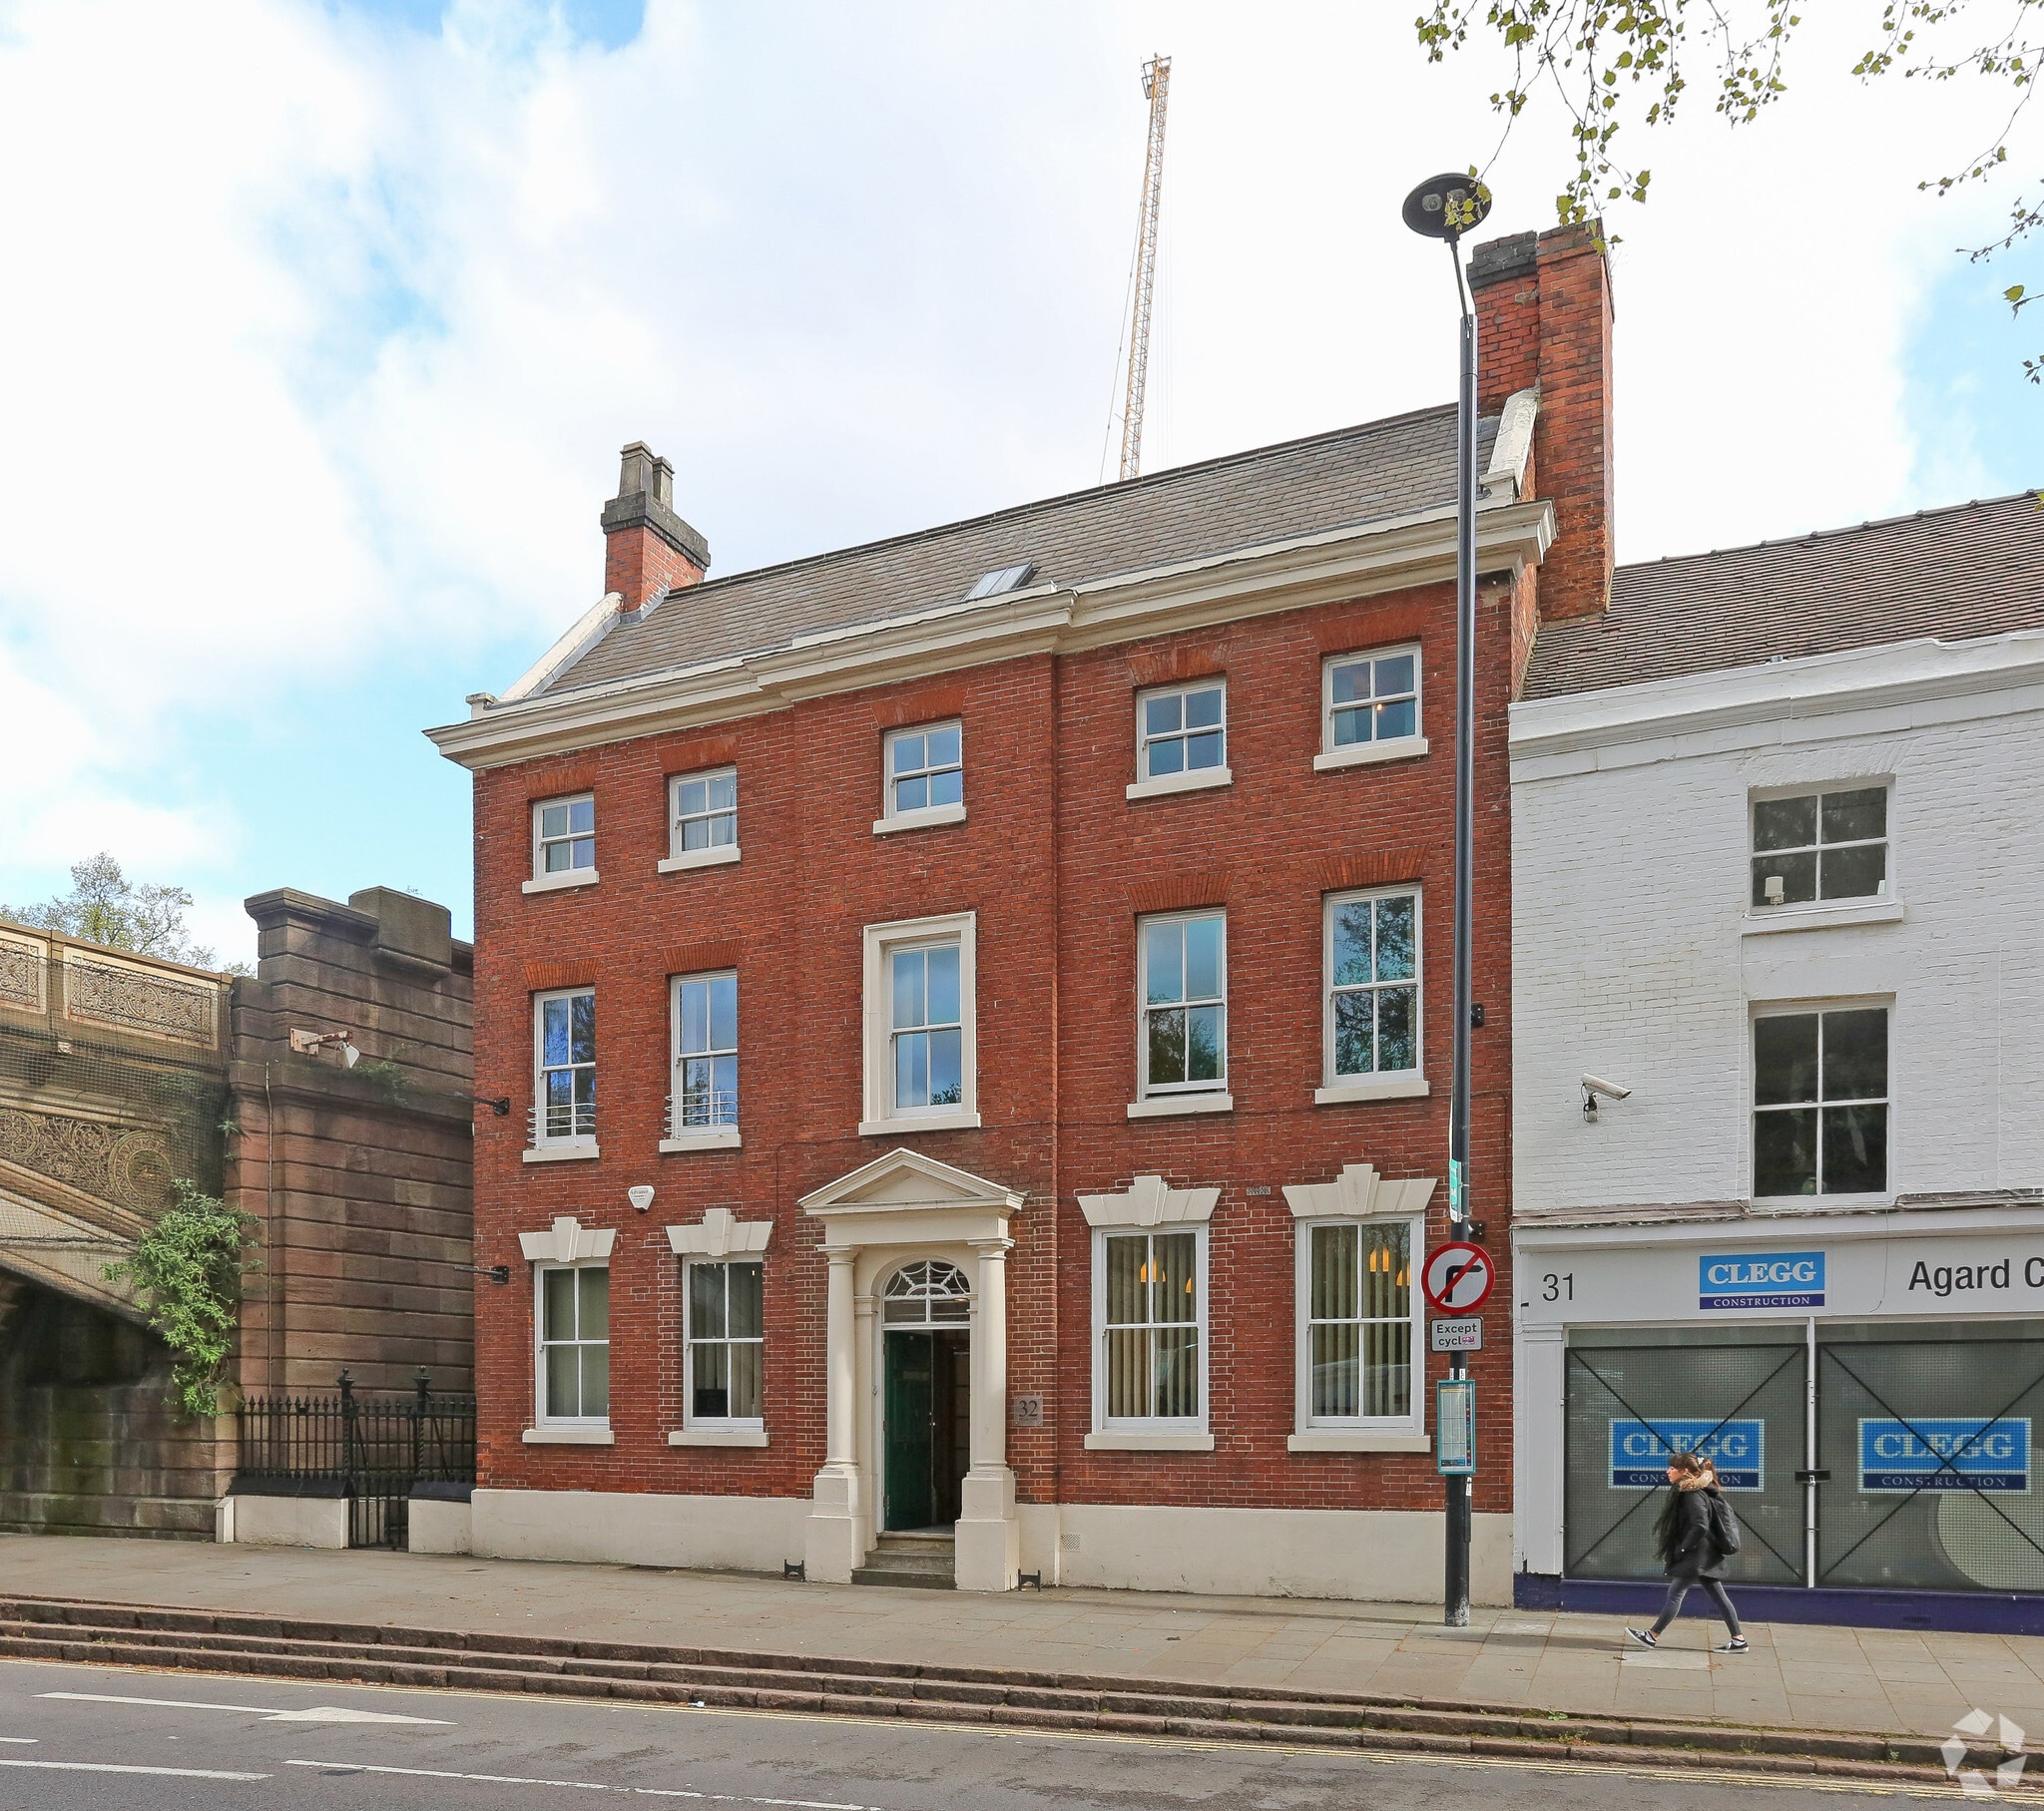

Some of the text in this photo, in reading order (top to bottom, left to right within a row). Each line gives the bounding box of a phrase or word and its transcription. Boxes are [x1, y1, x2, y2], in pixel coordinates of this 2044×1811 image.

[1708, 1261, 1816, 1285] CLEGG
[1908, 1258, 2010, 1297] Agard
[1542, 1272, 1574, 1302] 31
[1714, 1296, 1810, 1307] CONSTRUCTION
[1436, 1323, 1477, 1334] Except
[1018, 1400, 1038, 1417] 32
[1623, 1433, 1749, 1458] CLEGG
[1873, 1433, 2015, 1459] CLEGG
[1881, 1476, 2007, 1487] CONSTRUCTION
